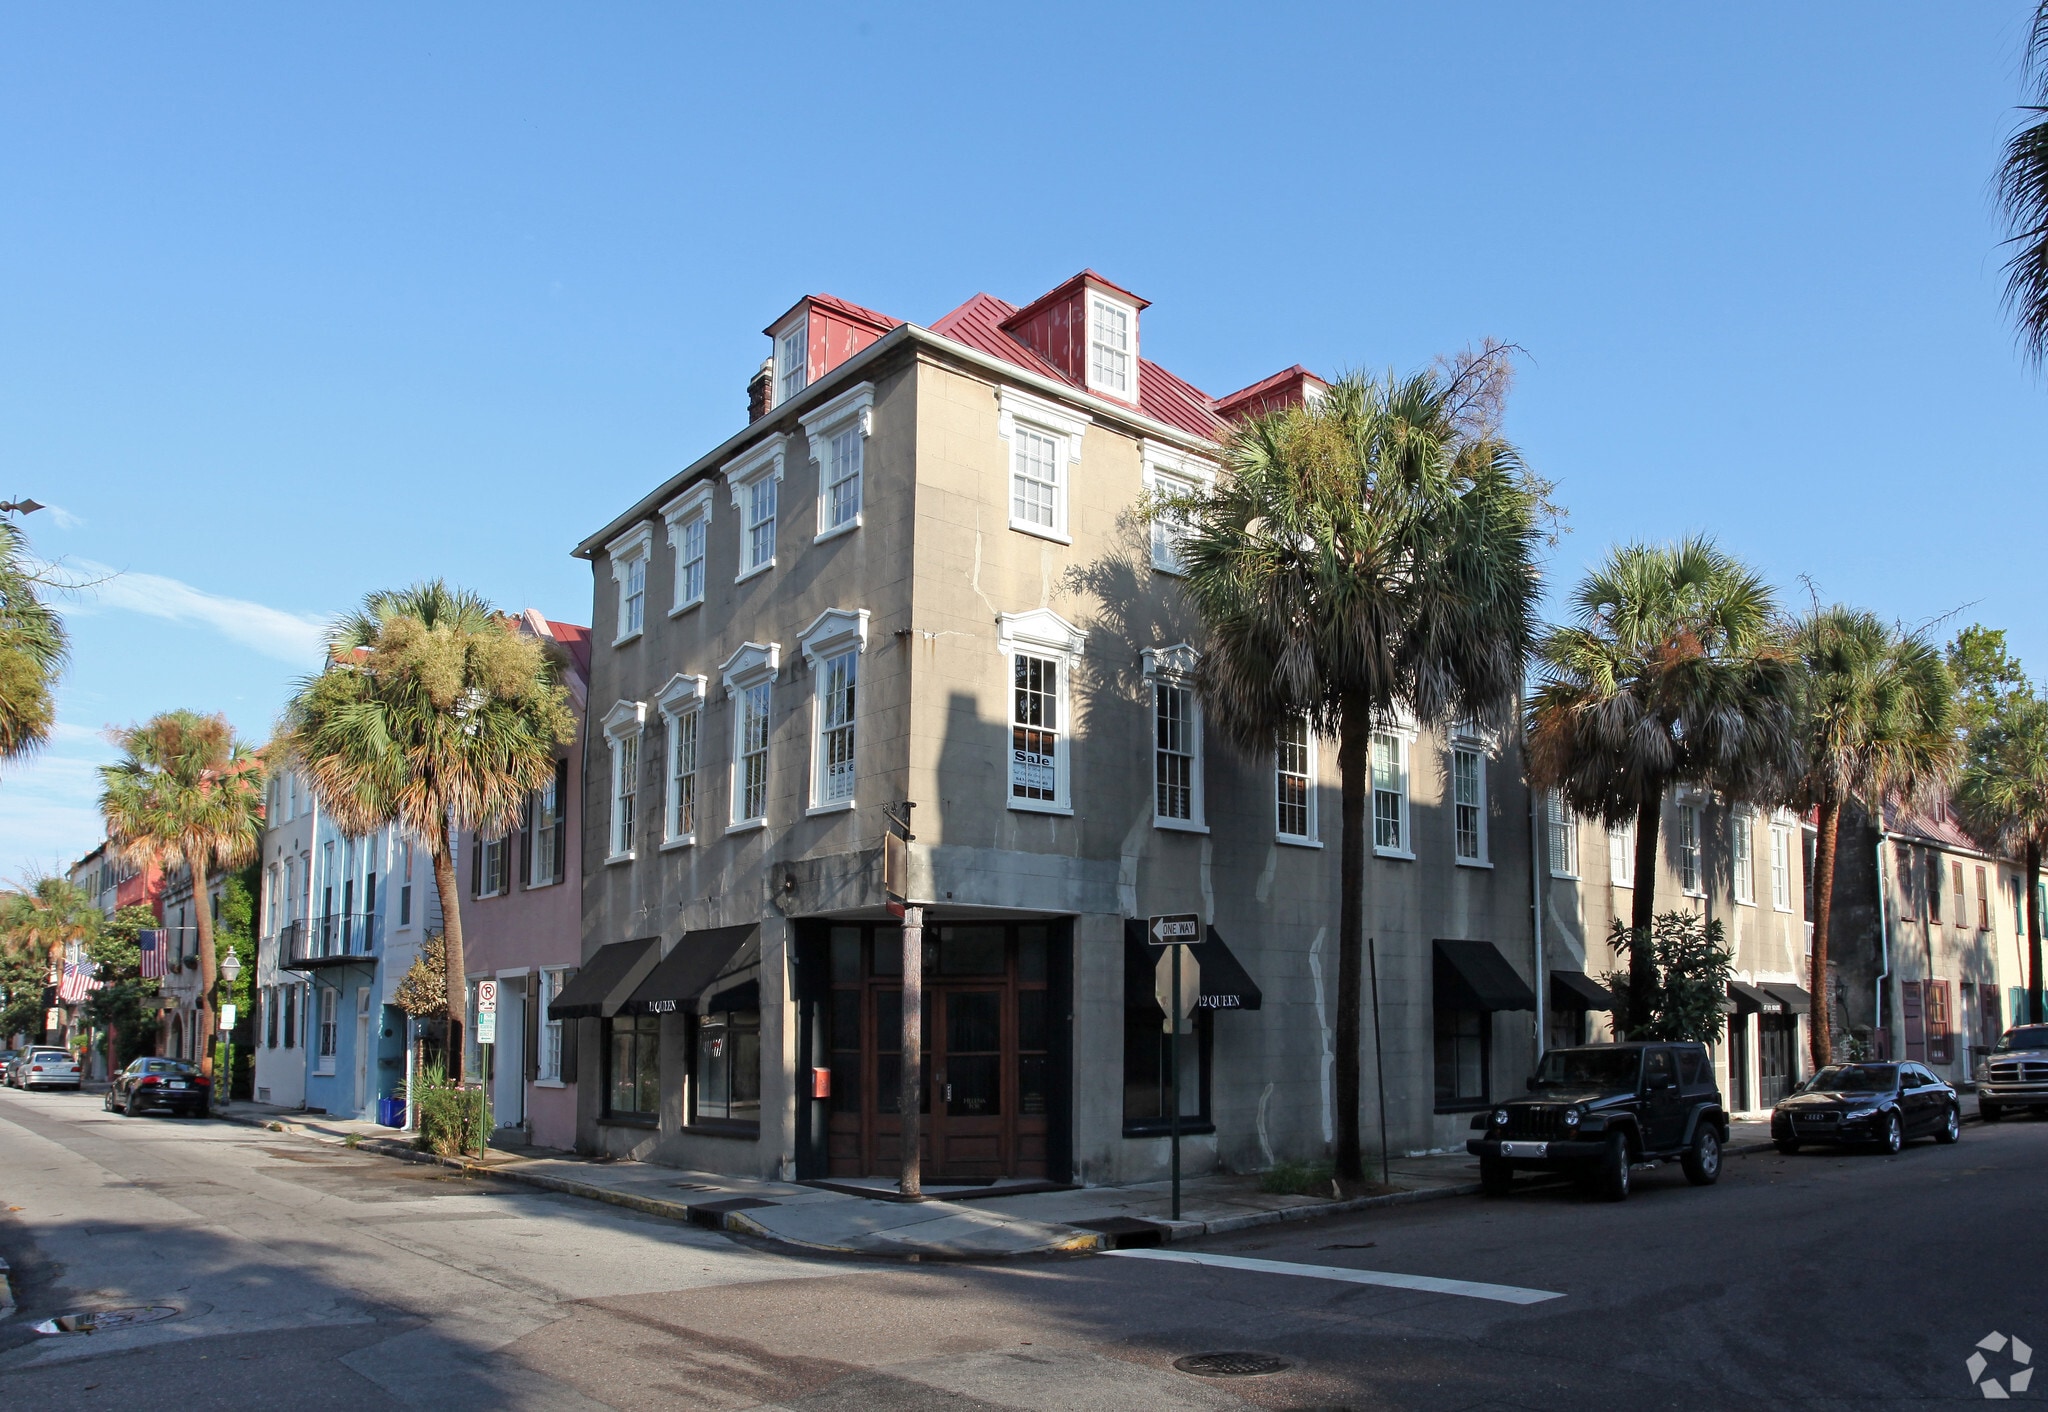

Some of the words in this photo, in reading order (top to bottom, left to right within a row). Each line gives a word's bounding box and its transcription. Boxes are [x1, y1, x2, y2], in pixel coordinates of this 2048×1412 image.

[1015, 751, 1050, 766] Sale
[830, 763, 854, 776] Sae
[1163, 923, 1177, 935] ONE
[1179, 922, 1194, 934] WAY
[655, 1000, 677, 1013] QUEEN
[1199, 995, 1208, 1007] 12
[1209, 995, 1240, 1009] QUEEN
